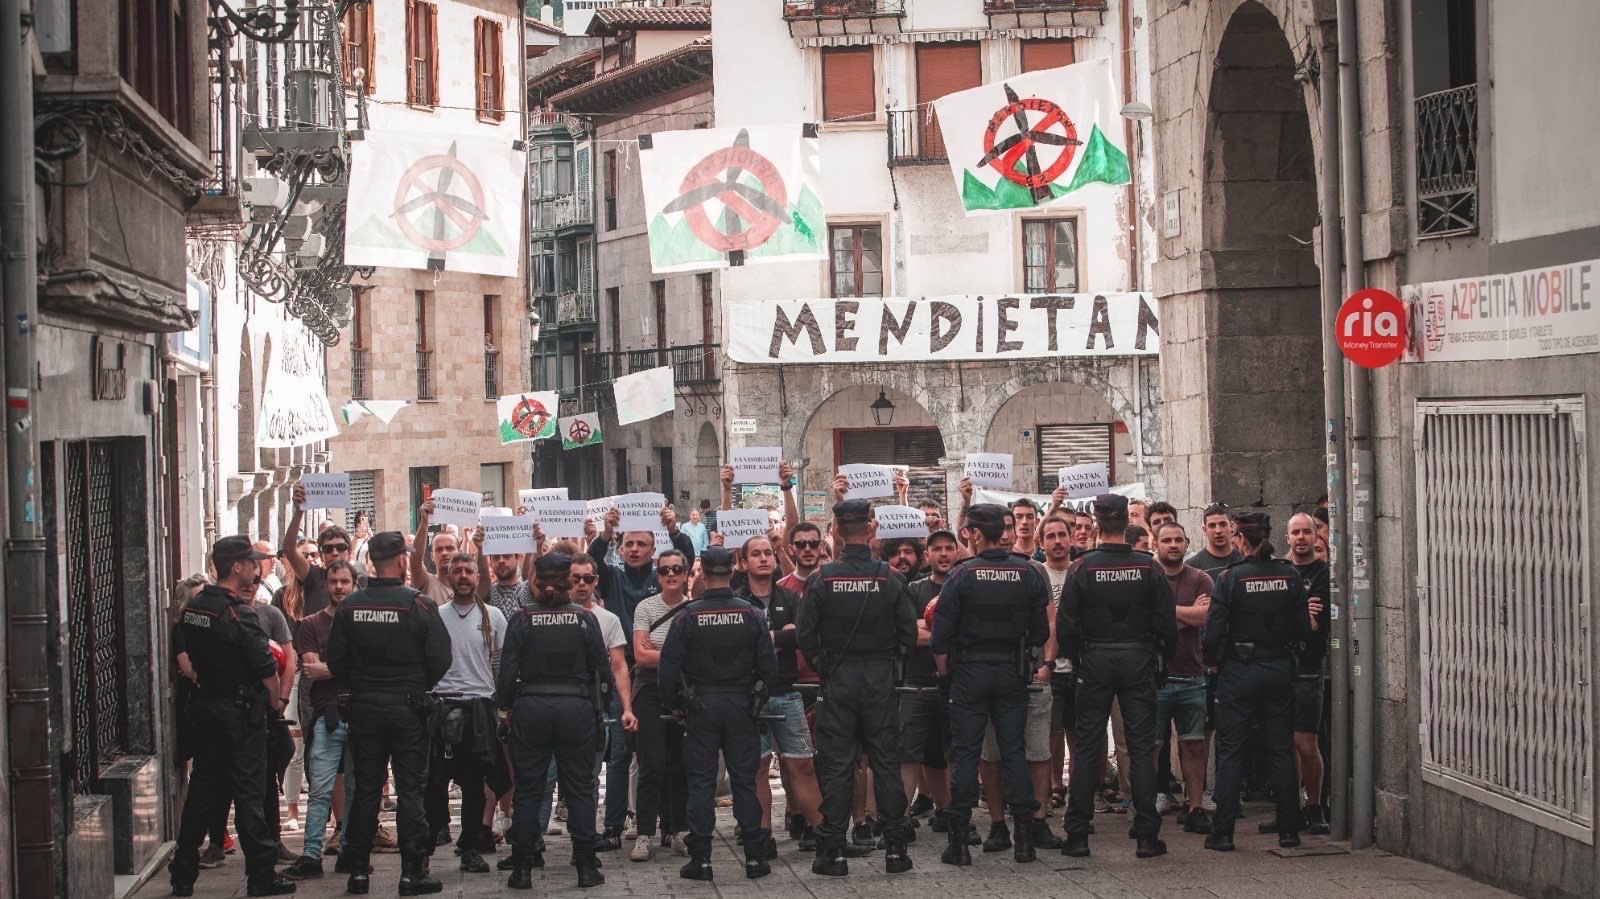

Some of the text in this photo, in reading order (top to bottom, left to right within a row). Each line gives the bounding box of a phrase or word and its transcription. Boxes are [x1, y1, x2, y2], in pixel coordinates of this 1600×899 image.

[1450, 265, 1592, 320] AZPEITIA MOBILE
[1344, 298, 1398, 337] ria
[1344, 341, 1398, 350] Money Transfer
[967, 461, 1006, 470] FAXISTAK
[847, 471, 885, 480] AXISTAK
[966, 470, 1009, 479] KANPORA!
[1061, 472, 1101, 482] FAXISTAK
[1062, 481, 1105, 491] KANPORA!
[587, 505, 610, 515] FAXIS
[879, 513, 922, 521] FAXISTAK
[720, 519, 762, 527] FAXISTAK
[880, 522, 925, 530] KANPORA!
[486, 524, 532, 533] FAXISMOARI
[975, 569, 1021, 582] ERTZAINTZA
[1095, 569, 1142, 582] ERTZAINTZA
[1245, 579, 1289, 593] ERTZAINTZA
[184, 611, 211, 628] ERTZAINTZA
[353, 609, 399, 623] ERTZAINTZA
[532, 613, 579, 626] ERTZAINTZA
[697, 613, 744, 626] ERTZAINTZA
